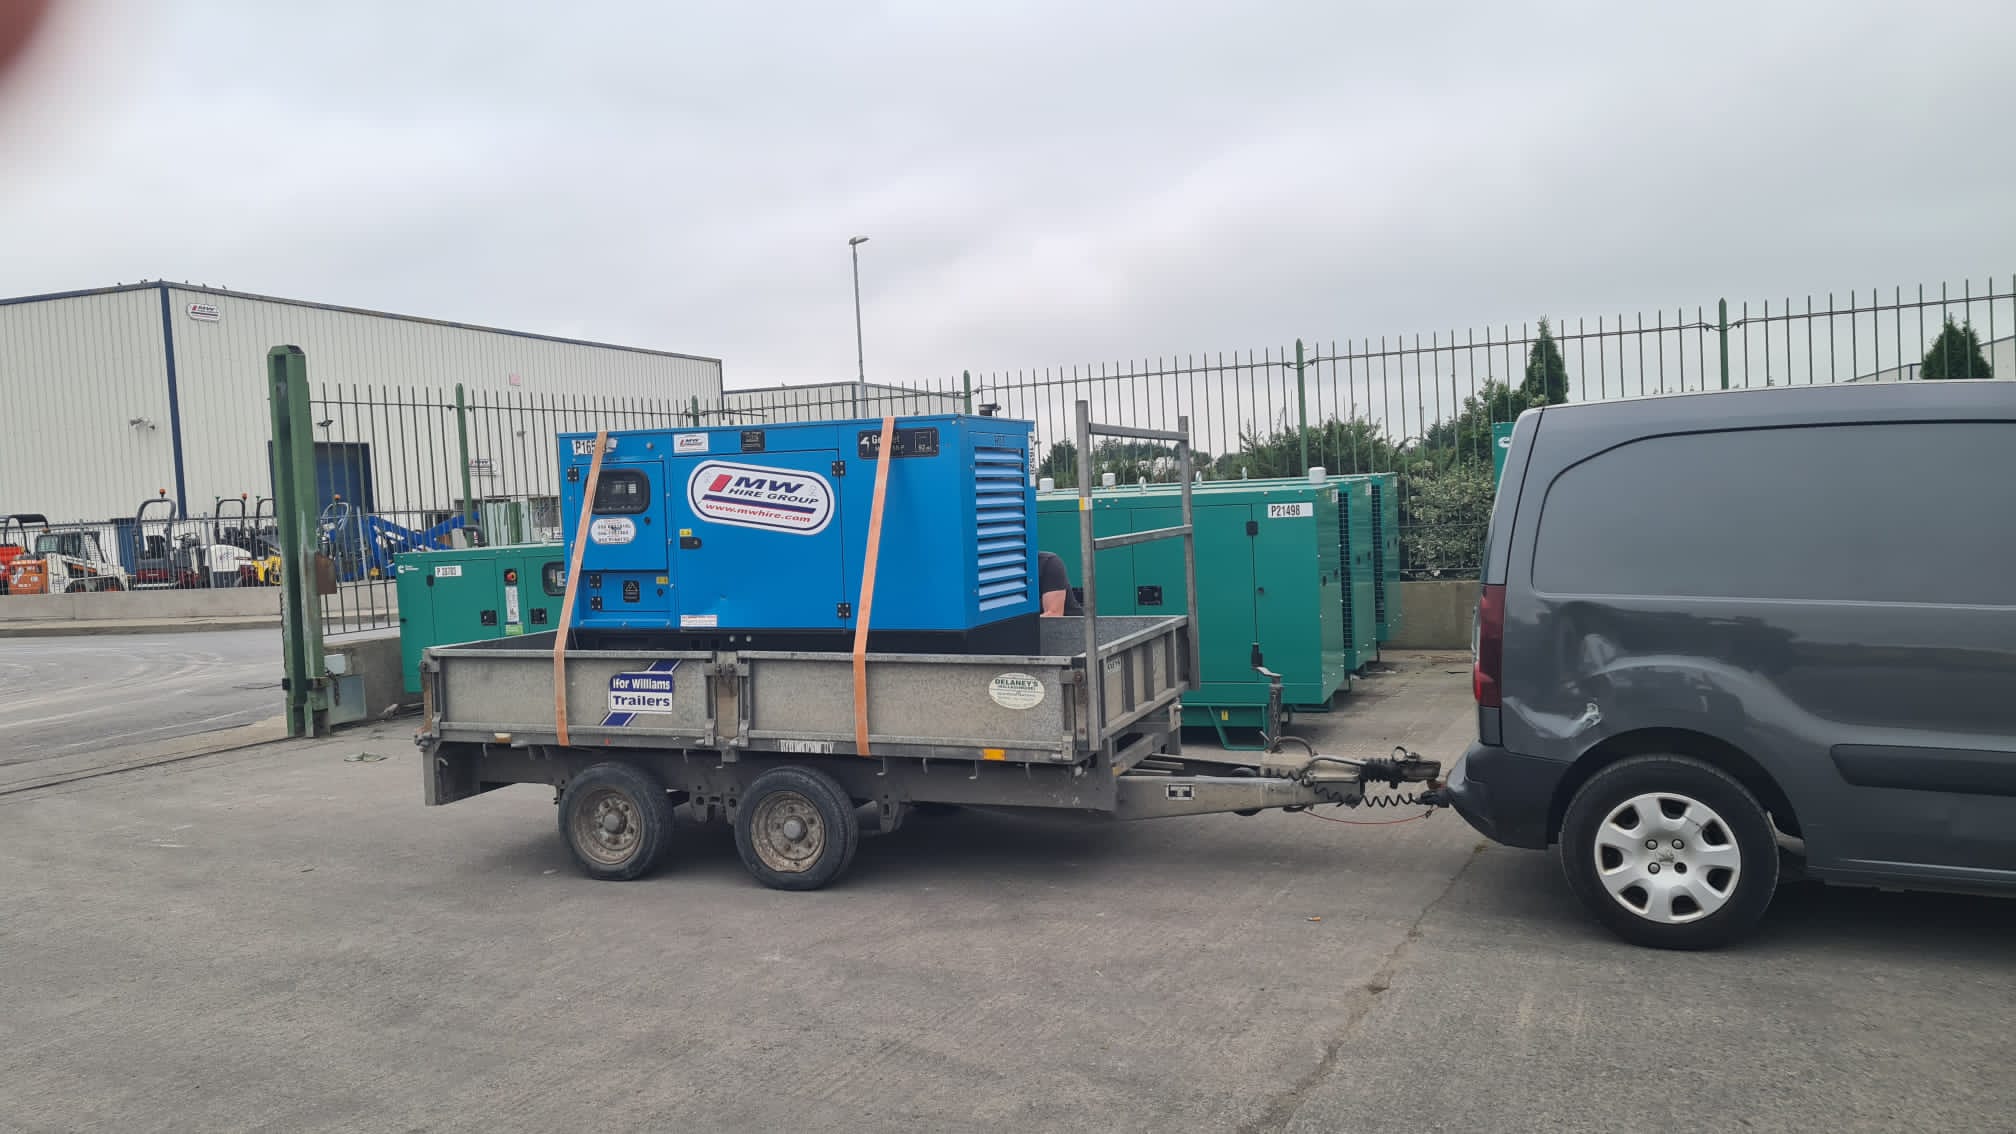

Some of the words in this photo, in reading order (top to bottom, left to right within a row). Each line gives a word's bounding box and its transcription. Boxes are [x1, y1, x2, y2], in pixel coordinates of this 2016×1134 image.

[734, 476, 804, 494] MW
[728, 488, 764, 498] HIRE
[767, 493, 819, 505] GROUP
[705, 503, 811, 523] www.mwhire.com
[1271, 504, 1301, 516] P21498
[612, 678, 630, 689] Ifor
[631, 678, 671, 690] Williams
[612, 695, 670, 707] Trailers
